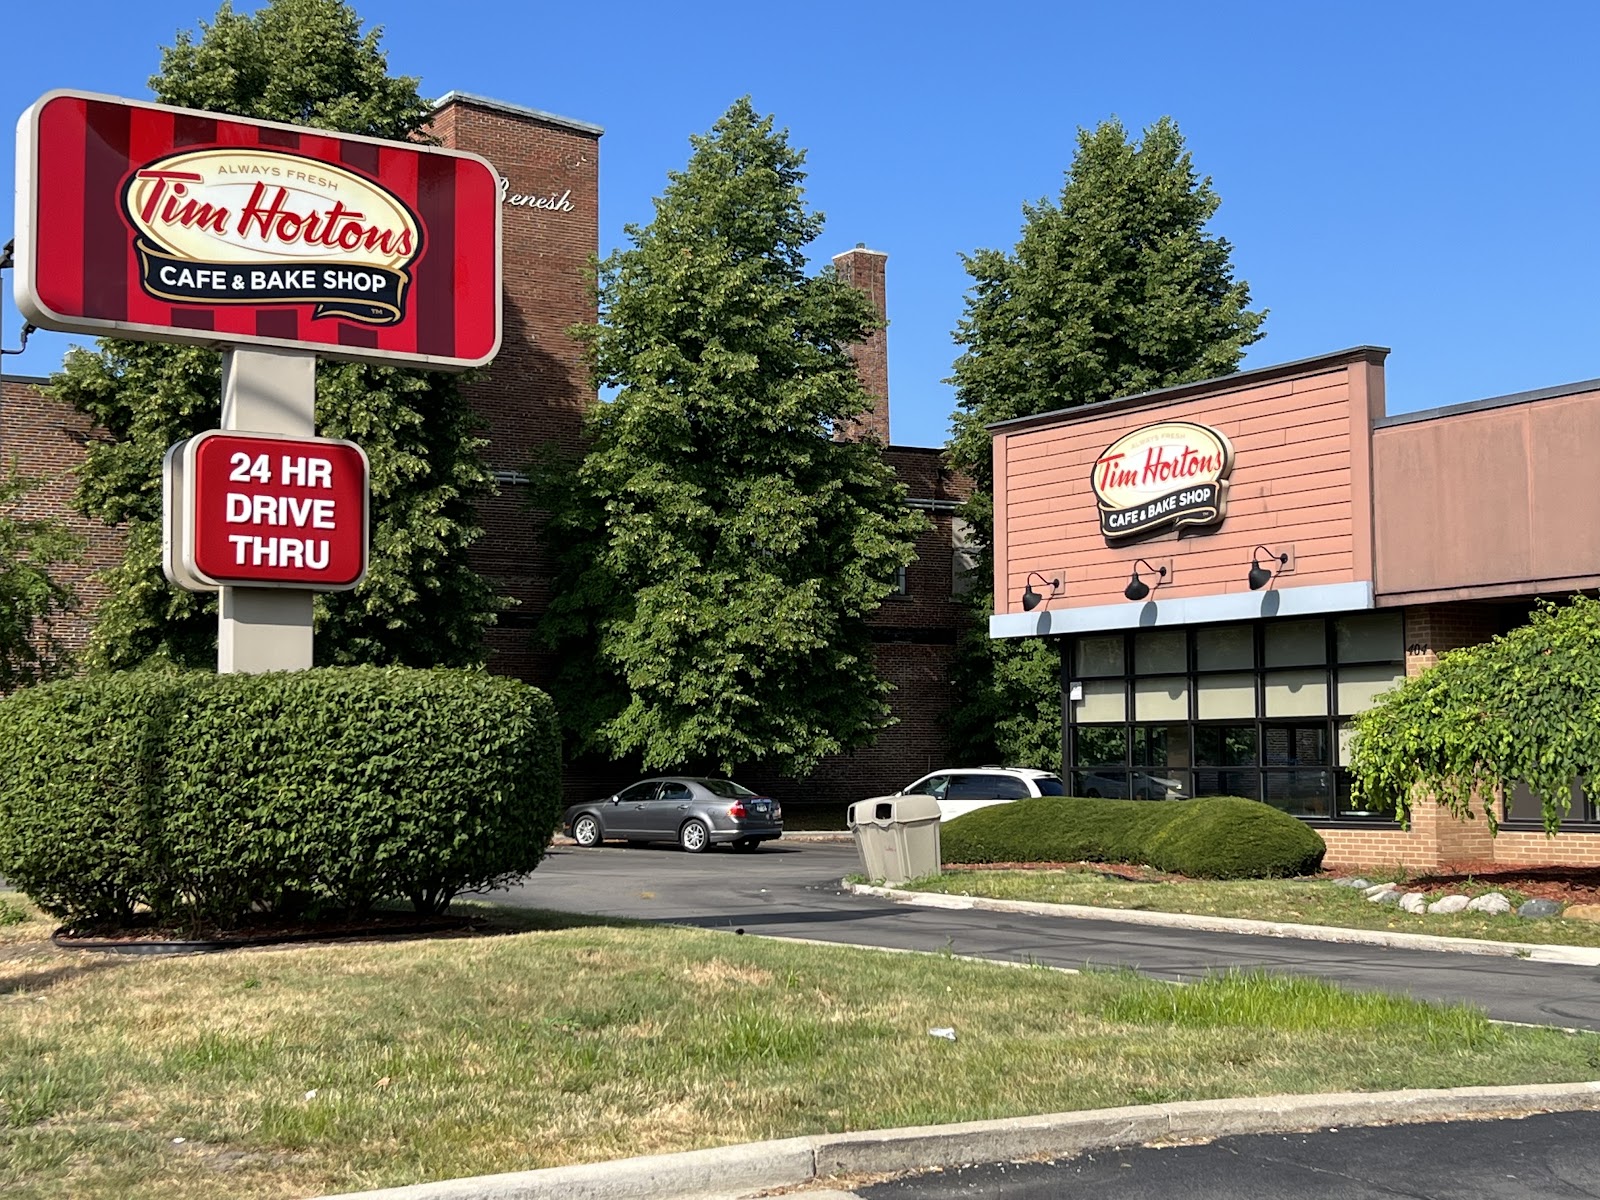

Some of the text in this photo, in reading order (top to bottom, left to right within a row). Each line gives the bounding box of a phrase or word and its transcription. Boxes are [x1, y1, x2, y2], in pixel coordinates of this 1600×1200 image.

[217, 164, 339, 191] ALWAYS FRESH
[137, 169, 413, 257] Tim Hortons
[159, 265, 388, 293] CAFE & BAKE SHOP
[1160, 432, 1187, 440] FRESH
[228, 451, 334, 489] 24 HR
[1096, 444, 1222, 492] Tim Hortons
[225, 492, 337, 530] DRIVE
[1108, 487, 1212, 528] CAFE & BAKE SHOP
[228, 534, 331, 570] THRU
